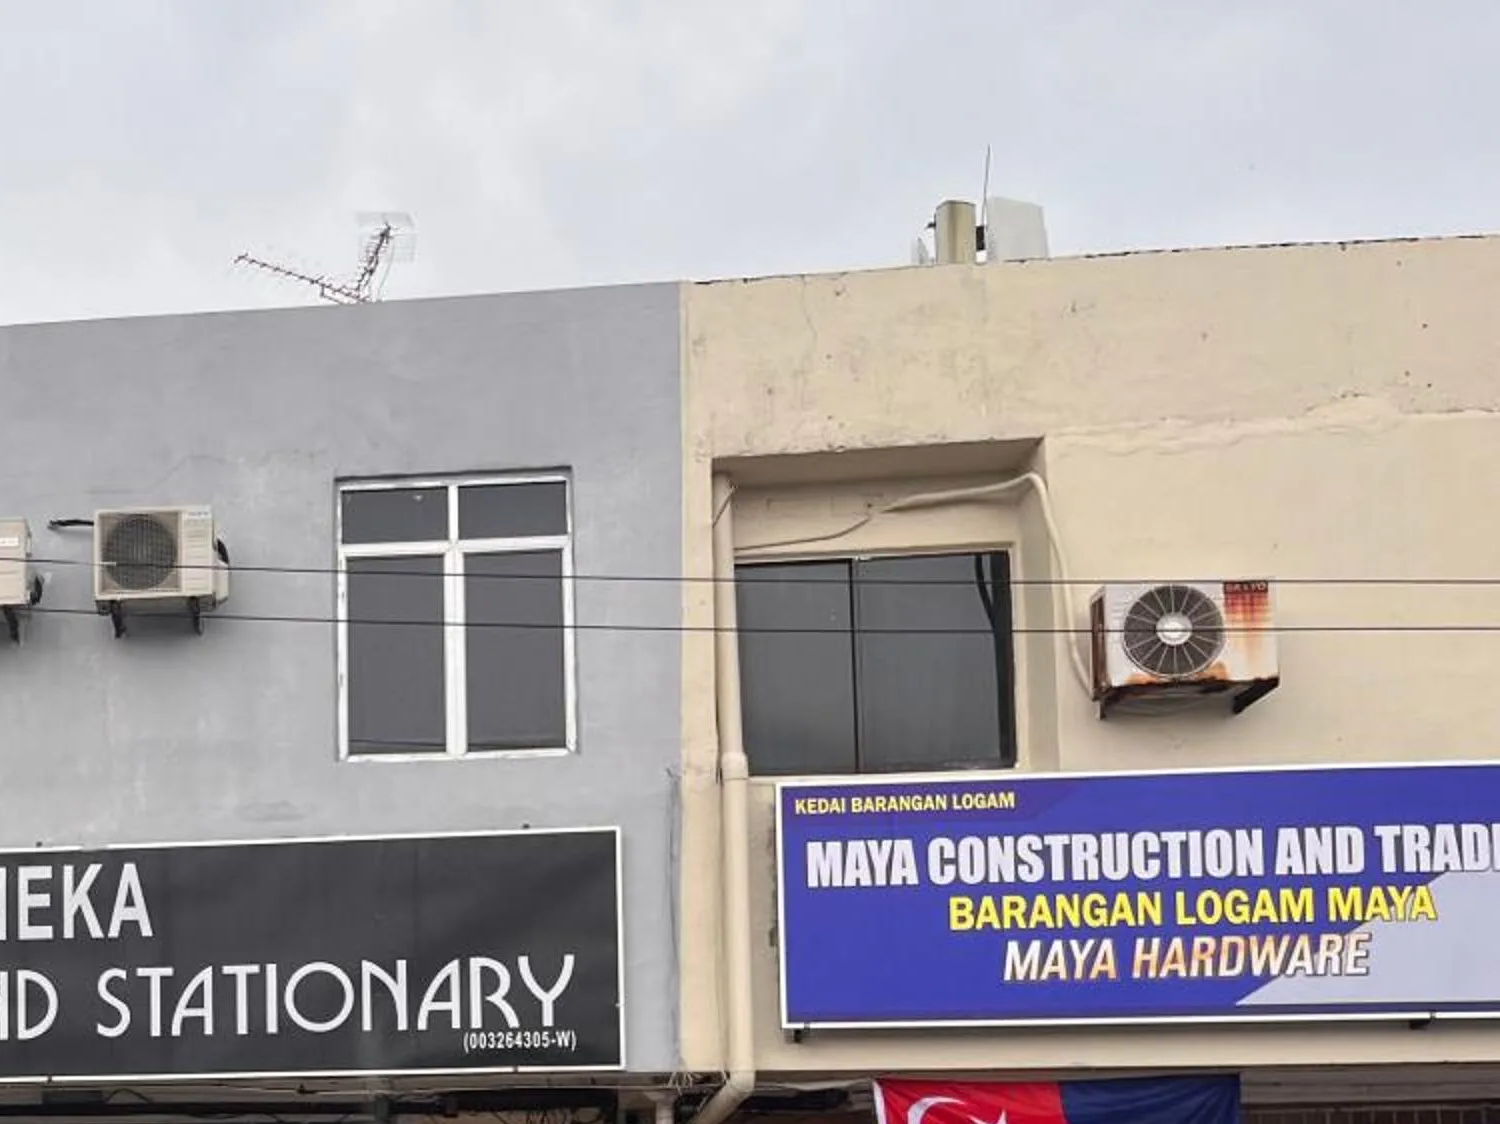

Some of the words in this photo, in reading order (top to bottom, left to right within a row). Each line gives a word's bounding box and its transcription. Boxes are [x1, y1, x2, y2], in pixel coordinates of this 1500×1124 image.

[795, 797, 846, 815] KEDAI
[852, 794, 948, 813] BARANGAN
[952, 791, 1016, 810] LOGAM
[806, 838, 920, 888] MAYA
[927, 828, 1265, 886] CONSTRUCTION
[1275, 825, 1366, 876] AND
[949, 891, 1162, 931] BARANGAN
[1175, 887, 1315, 926] LOGAM
[1328, 884, 1439, 923] MAYA
[1003, 937, 1118, 982] MAYA
[1132, 930, 1373, 980] HARDWARE
[96, 953, 576, 1038] STATIONARY
[462, 1030, 578, 1054] (003264305-W)
